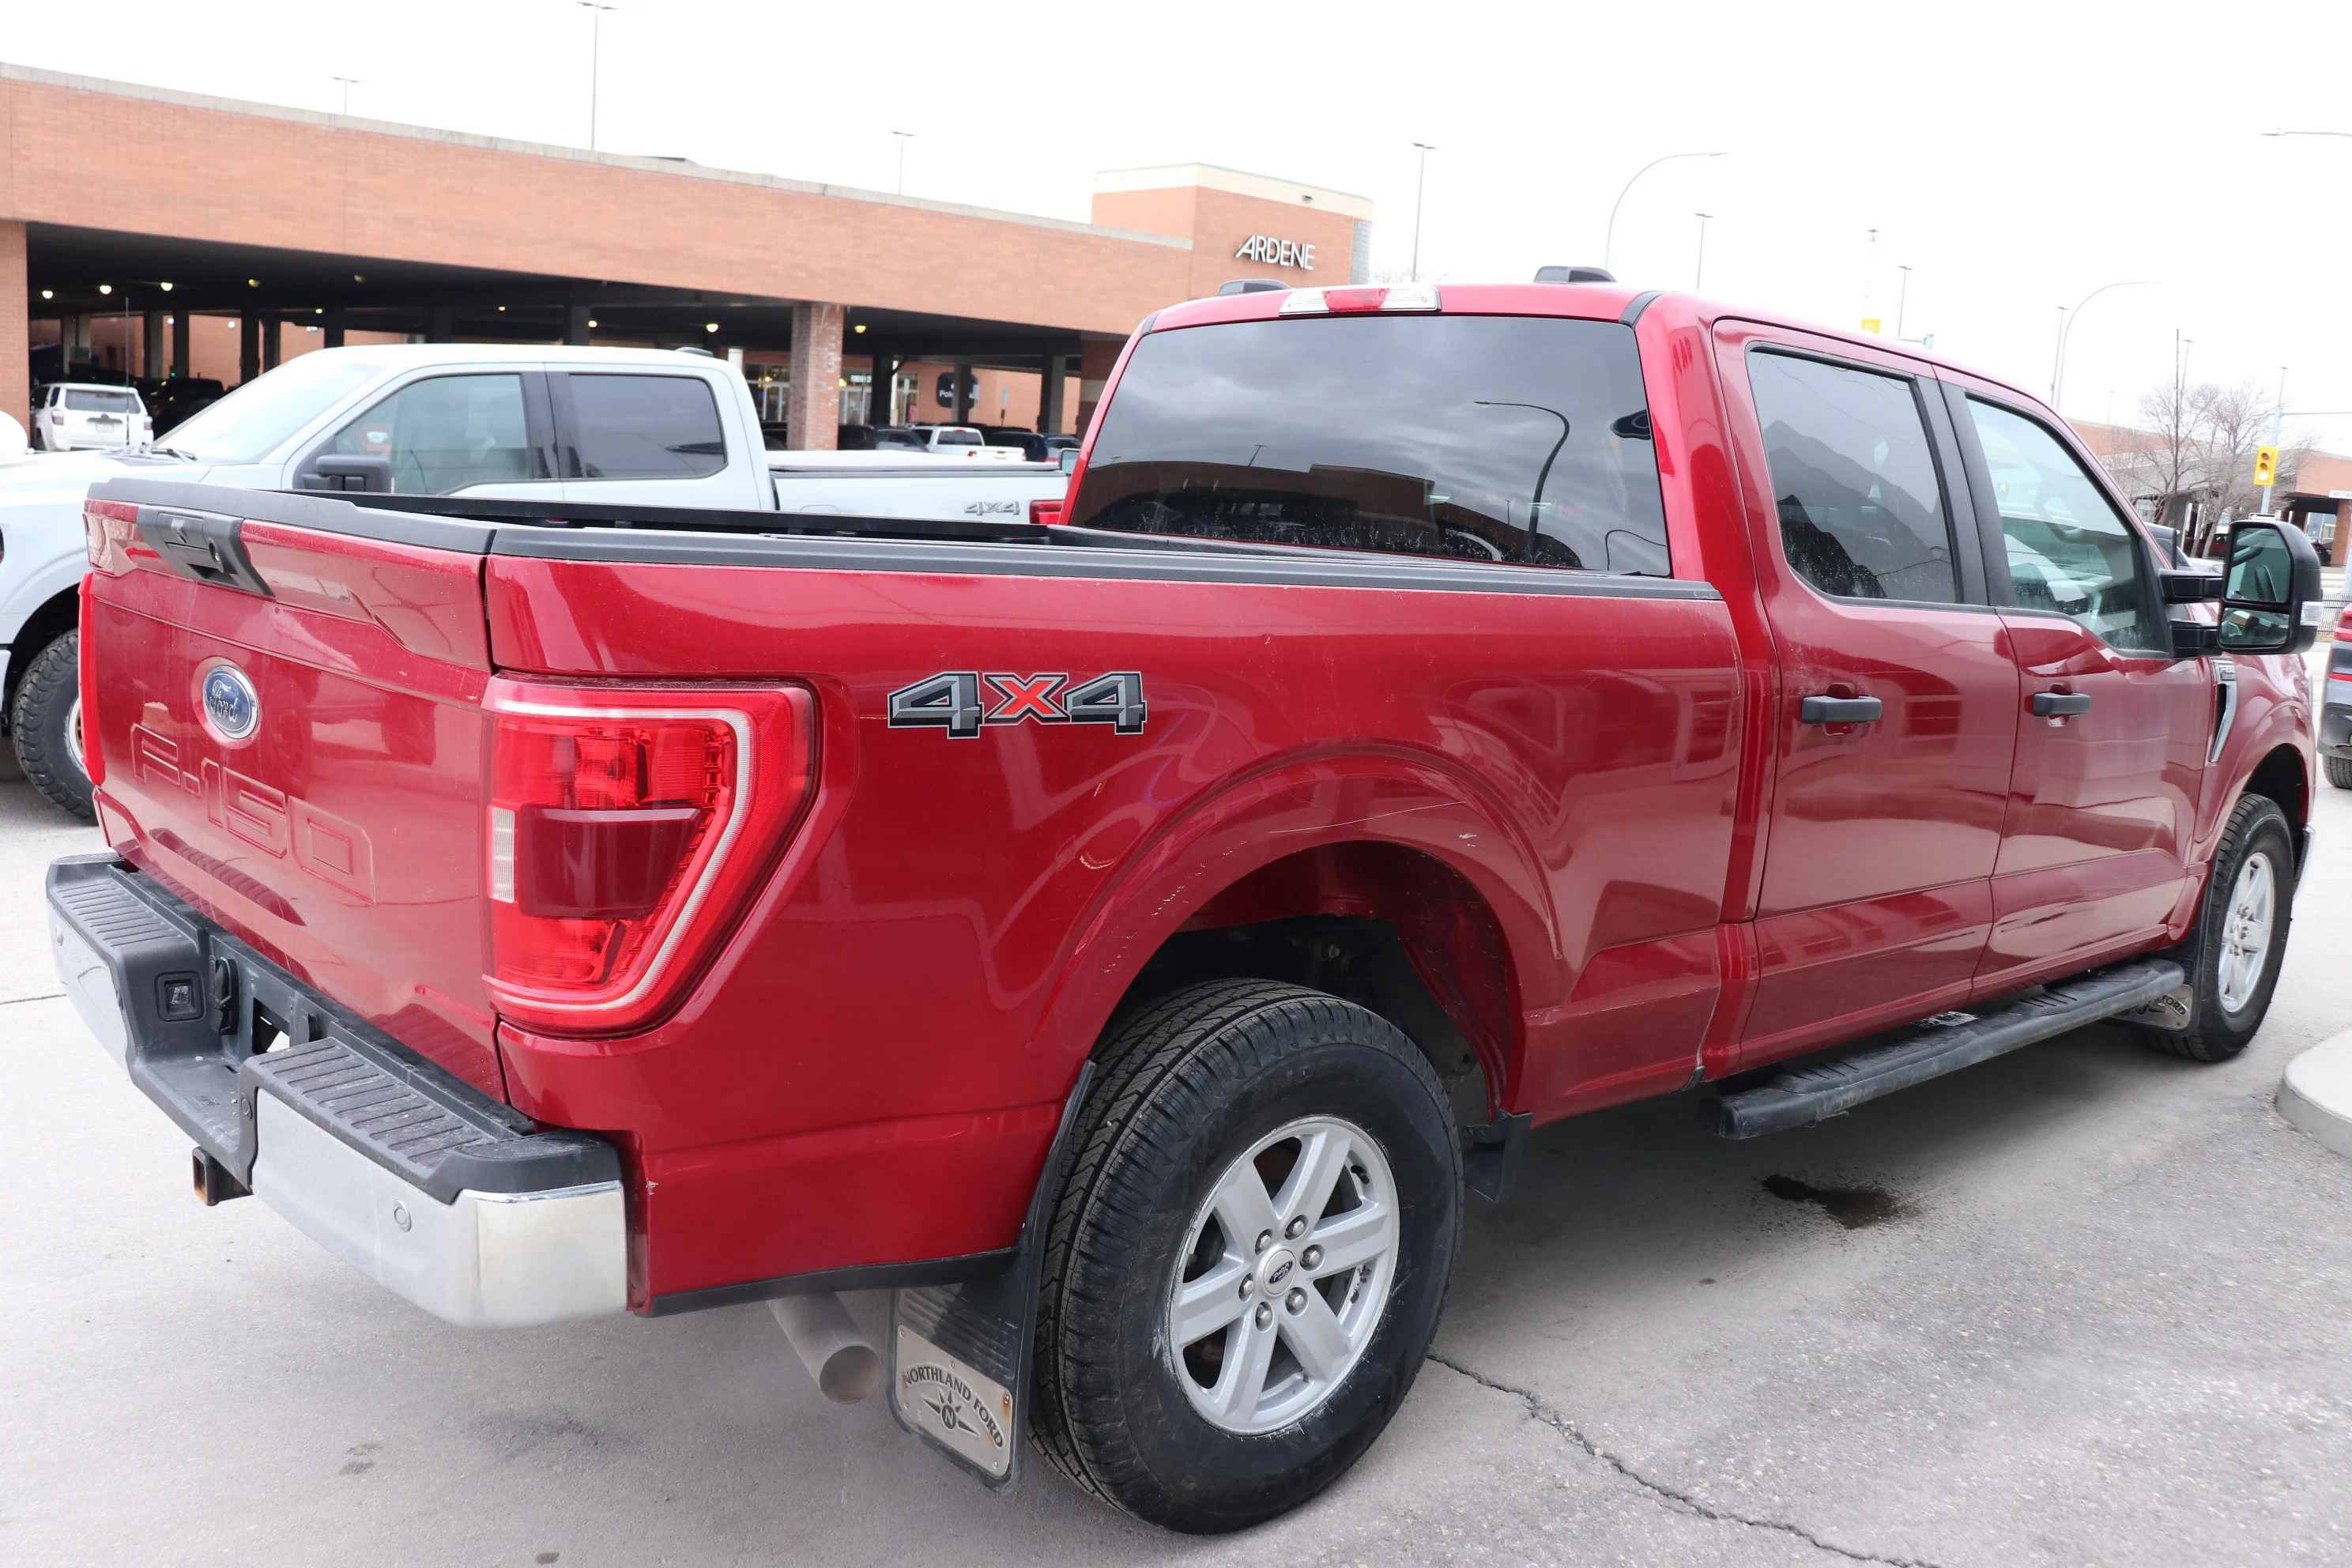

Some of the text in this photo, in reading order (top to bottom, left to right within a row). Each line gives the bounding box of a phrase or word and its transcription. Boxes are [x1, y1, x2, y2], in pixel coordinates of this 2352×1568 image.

[1235, 235, 1316, 270] ARDENE
[964, 501, 1020, 516] 4X4
[209, 680, 239, 723] Ford
[888, 671, 1148, 739] 4X4
[130, 722, 376, 906] F-150
[2162, 995, 2186, 1015] FORD
[904, 1366, 1004, 1448] NORTHLAND FORD
